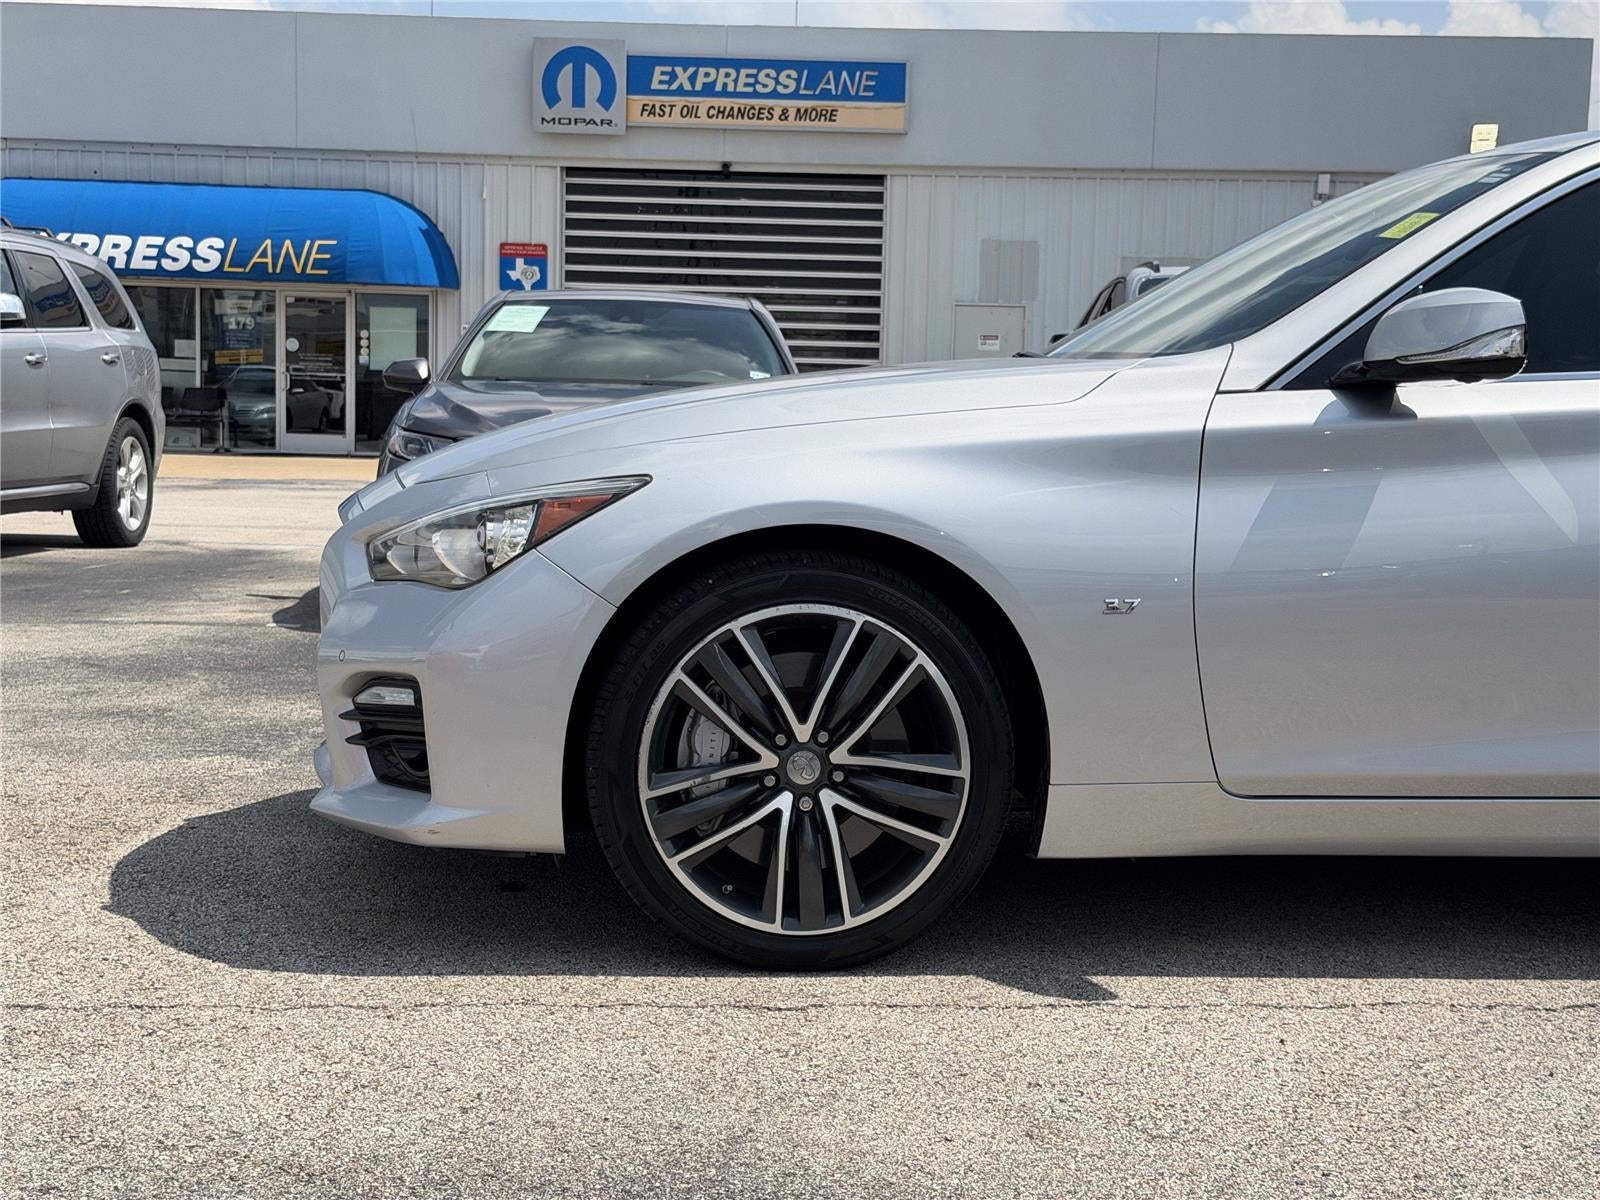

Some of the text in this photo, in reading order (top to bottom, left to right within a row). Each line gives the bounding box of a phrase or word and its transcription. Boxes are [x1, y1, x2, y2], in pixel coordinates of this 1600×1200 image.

[640, 103, 839, 123] FAST OIL CHANGES & MORE
[1102, 598, 1141, 615] 3.7
